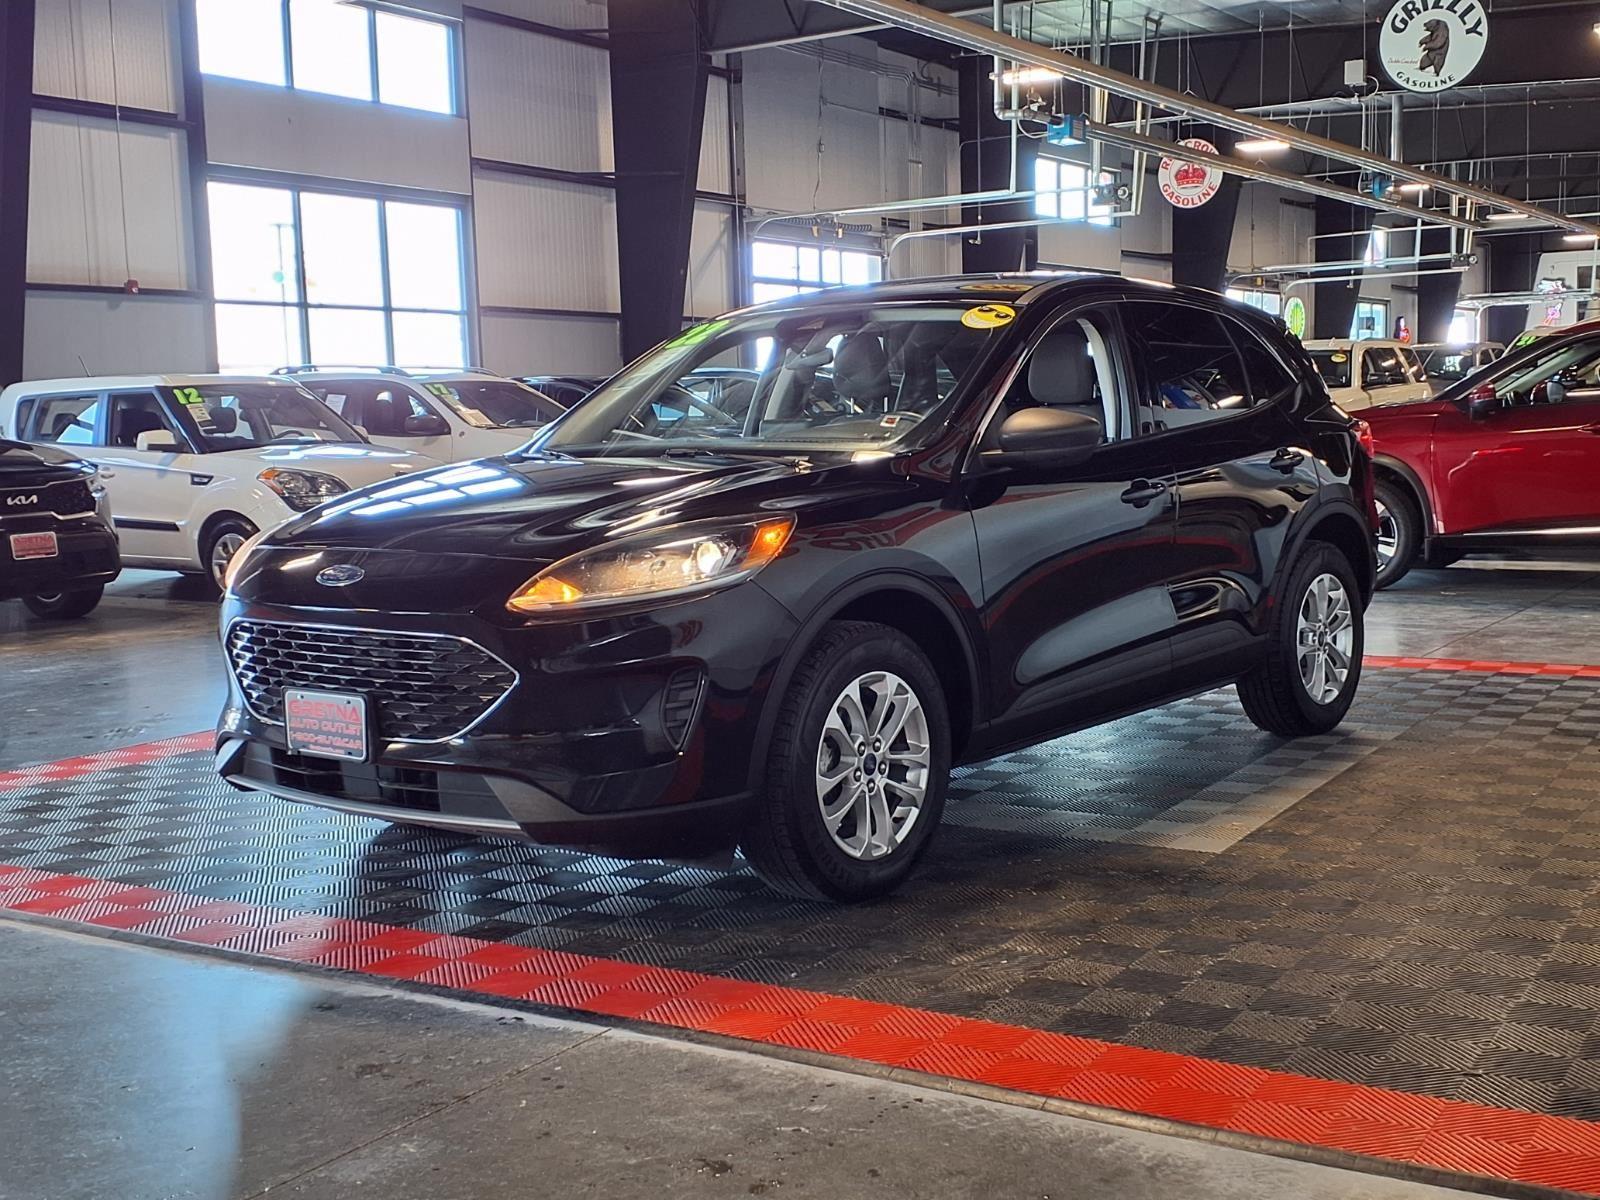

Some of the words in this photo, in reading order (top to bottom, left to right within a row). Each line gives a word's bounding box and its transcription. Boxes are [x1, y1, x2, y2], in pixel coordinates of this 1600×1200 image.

[1396, 71, 1456, 88] GASOLINE
[1184, 140, 1216, 154] CRO
[1162, 182, 1217, 206] GASOLINE
[173, 387, 203, 404] 12
[289, 718, 319, 730] AUTO
